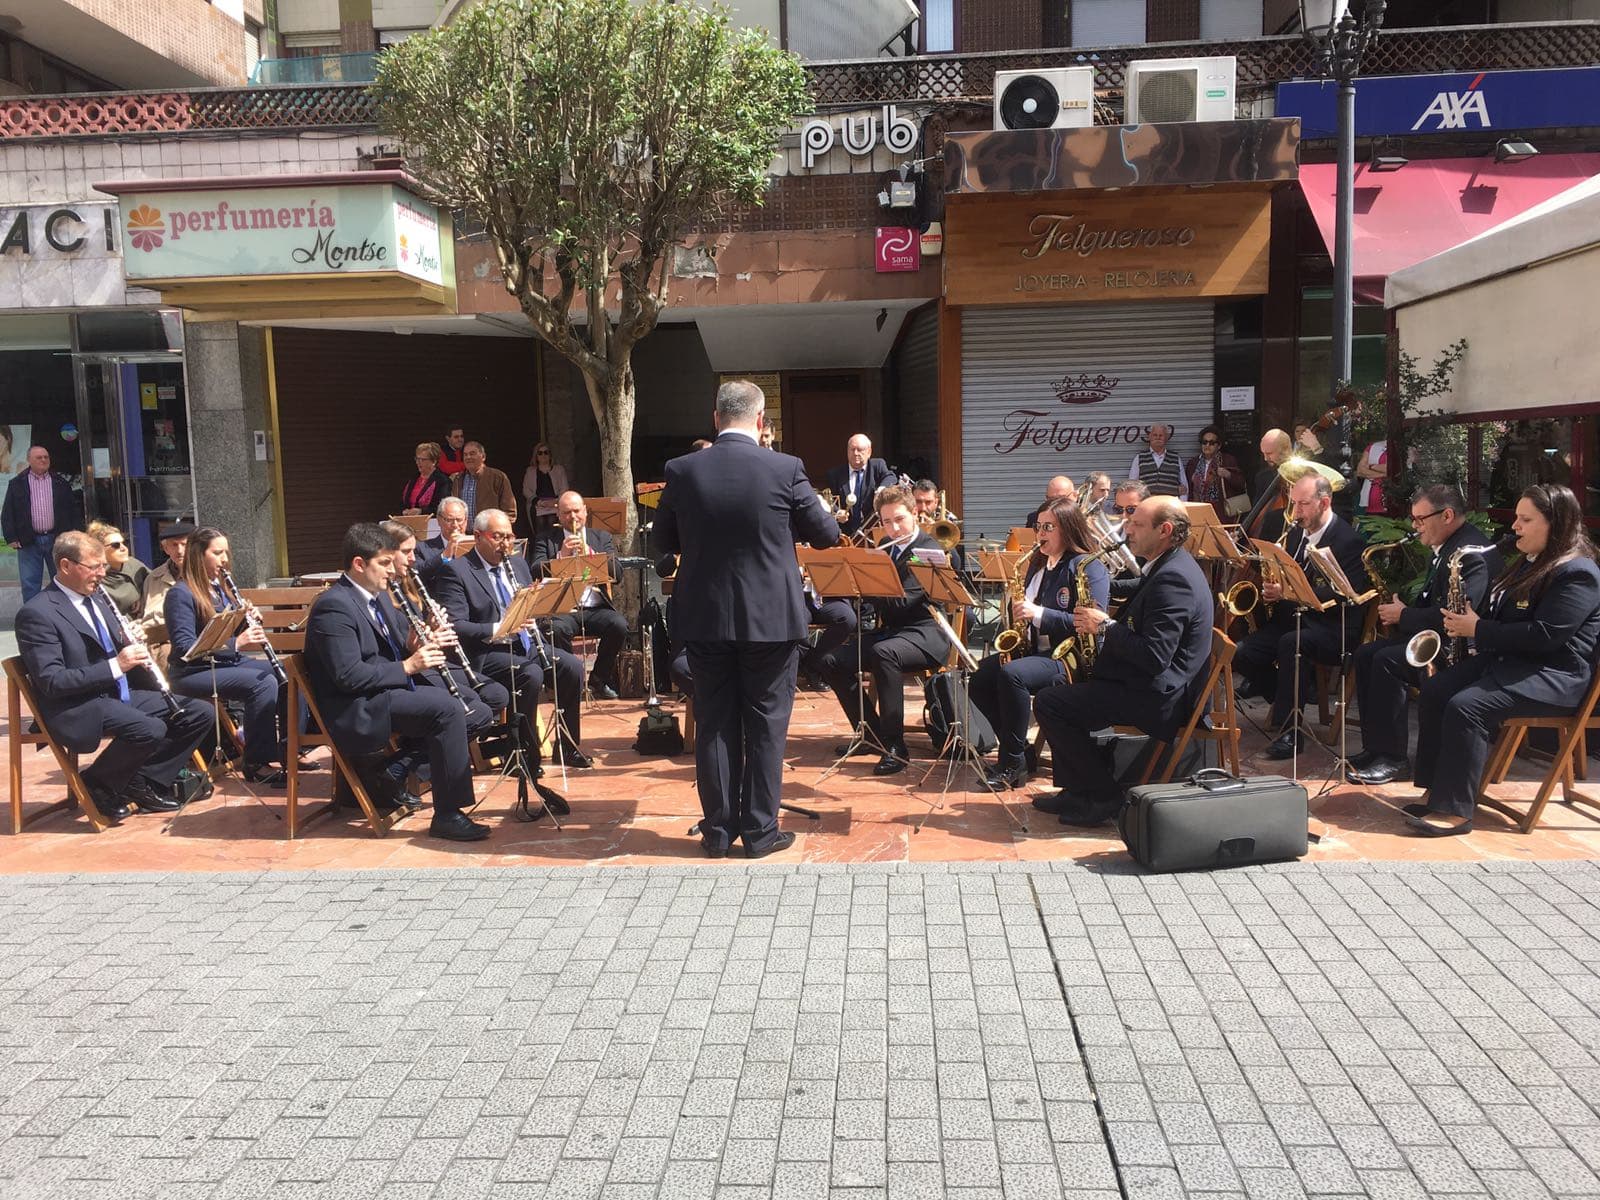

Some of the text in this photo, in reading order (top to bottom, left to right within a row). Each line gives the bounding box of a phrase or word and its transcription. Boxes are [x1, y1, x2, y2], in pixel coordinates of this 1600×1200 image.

[1410, 89, 1492, 131] AXA
[800, 104, 919, 169] pub
[168, 200, 336, 240] perfumería
[1021, 214, 1196, 260] Felgueroso
[292, 229, 388, 269] Montse
[891, 255, 914, 264] sama
